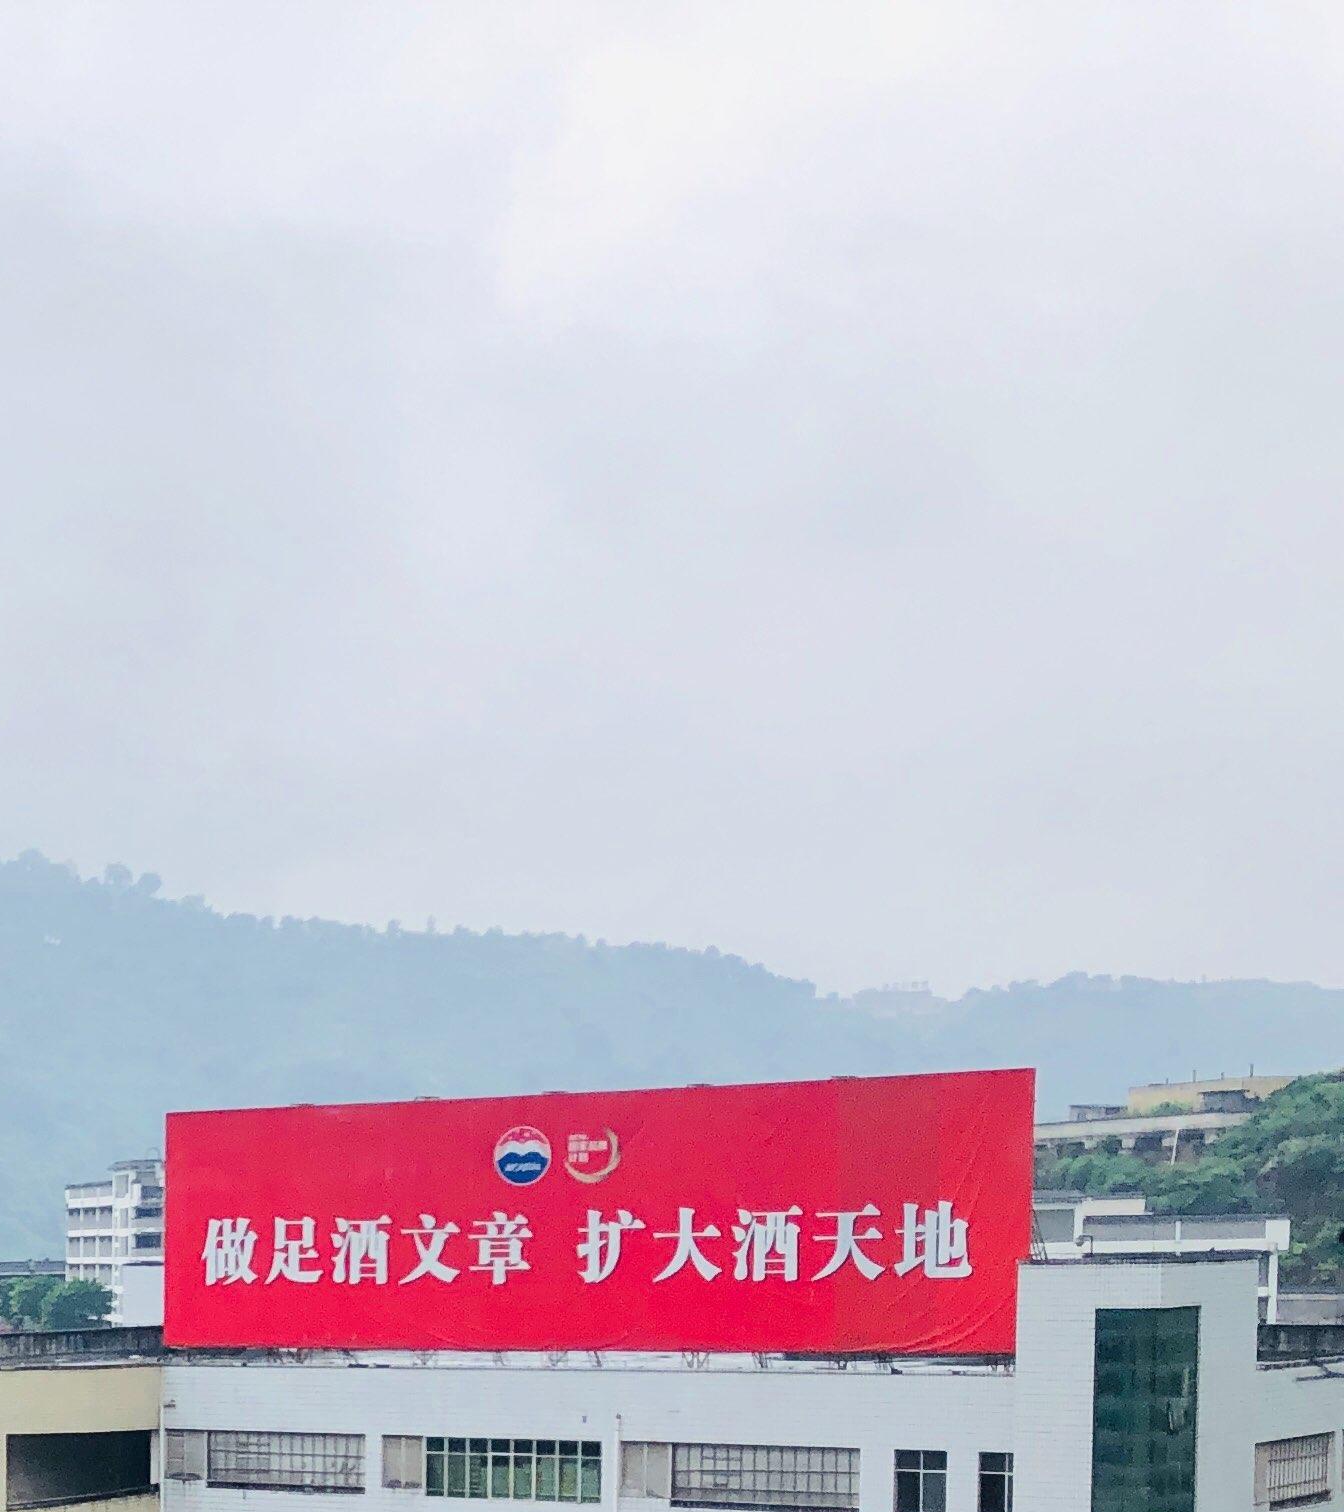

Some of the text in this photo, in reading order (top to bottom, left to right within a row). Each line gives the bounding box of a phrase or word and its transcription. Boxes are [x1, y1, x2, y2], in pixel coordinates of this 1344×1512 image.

[201, 1200, 974, 1286] 做足酒文章 扩大酒天地
